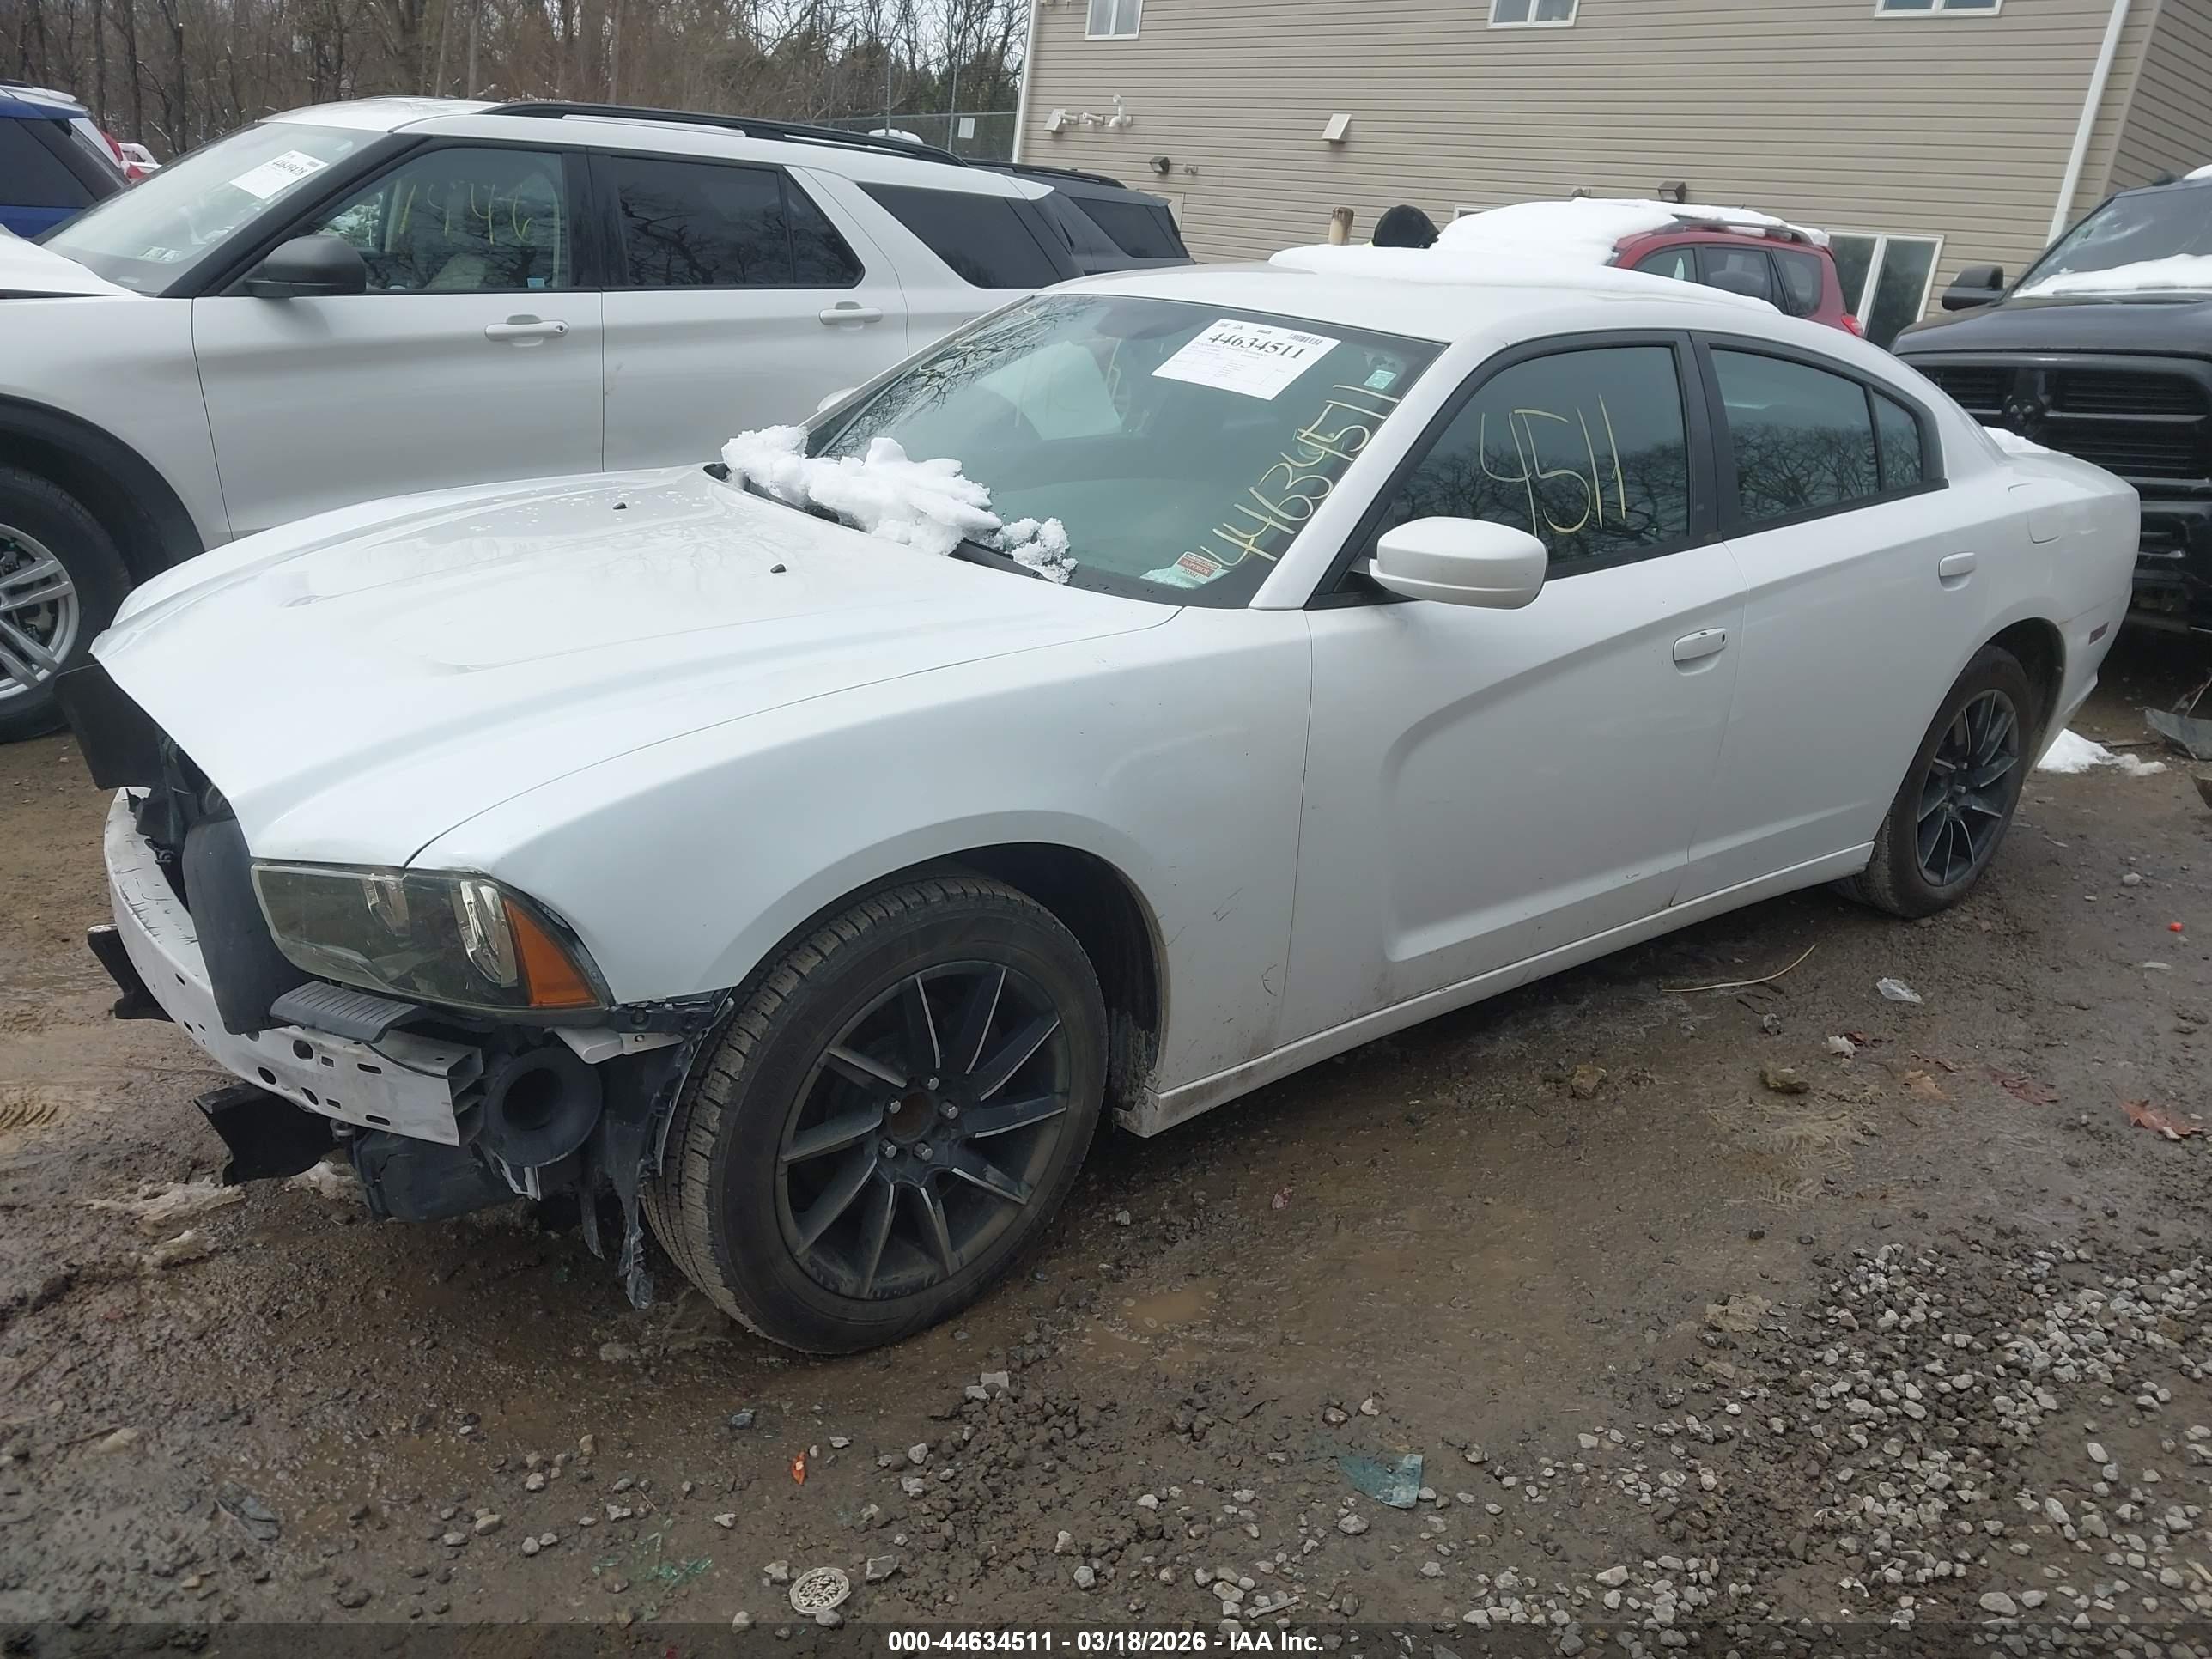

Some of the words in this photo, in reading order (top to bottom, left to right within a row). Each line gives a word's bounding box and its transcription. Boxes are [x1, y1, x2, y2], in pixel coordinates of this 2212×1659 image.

[1208, 332, 1306, 359] 44634511
[1200, 384, 1400, 567] 44634511
[1480, 392, 1626, 538] 4511
